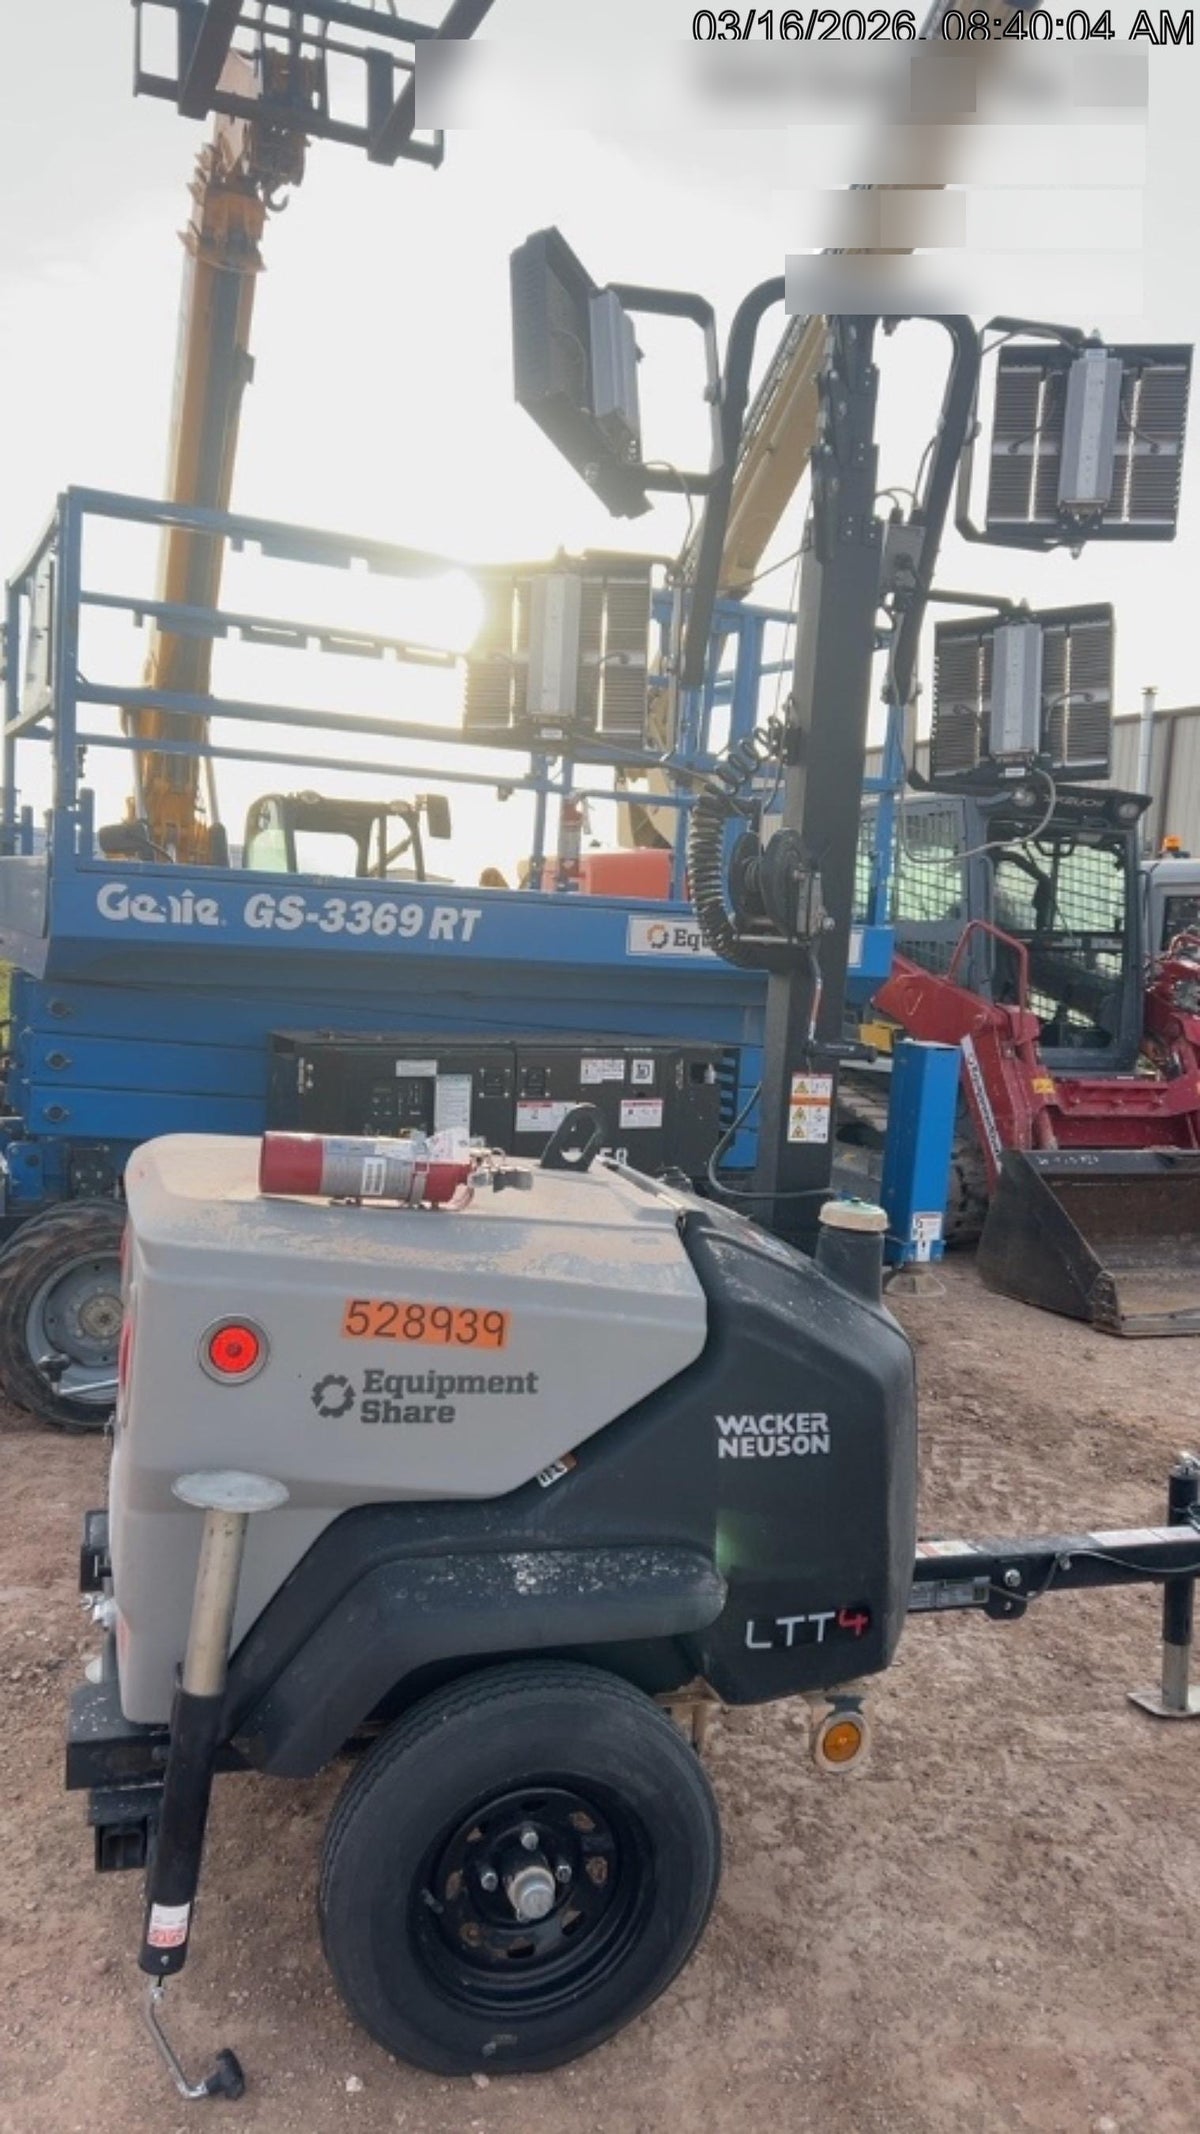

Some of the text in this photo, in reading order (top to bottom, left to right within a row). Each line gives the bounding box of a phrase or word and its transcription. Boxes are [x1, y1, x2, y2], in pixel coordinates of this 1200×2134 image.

[97, 882, 482, 942] Genie GS-3369 RT
[345, 1300, 505, 1347] 528939
[363, 1369, 539, 1399] Equipment
[360, 1400, 456, 1424] Share
[715, 1412, 830, 1436] WACKER
[718, 1434, 831, 1458] NEUSON
[746, 1609, 869, 1648] LTT4
